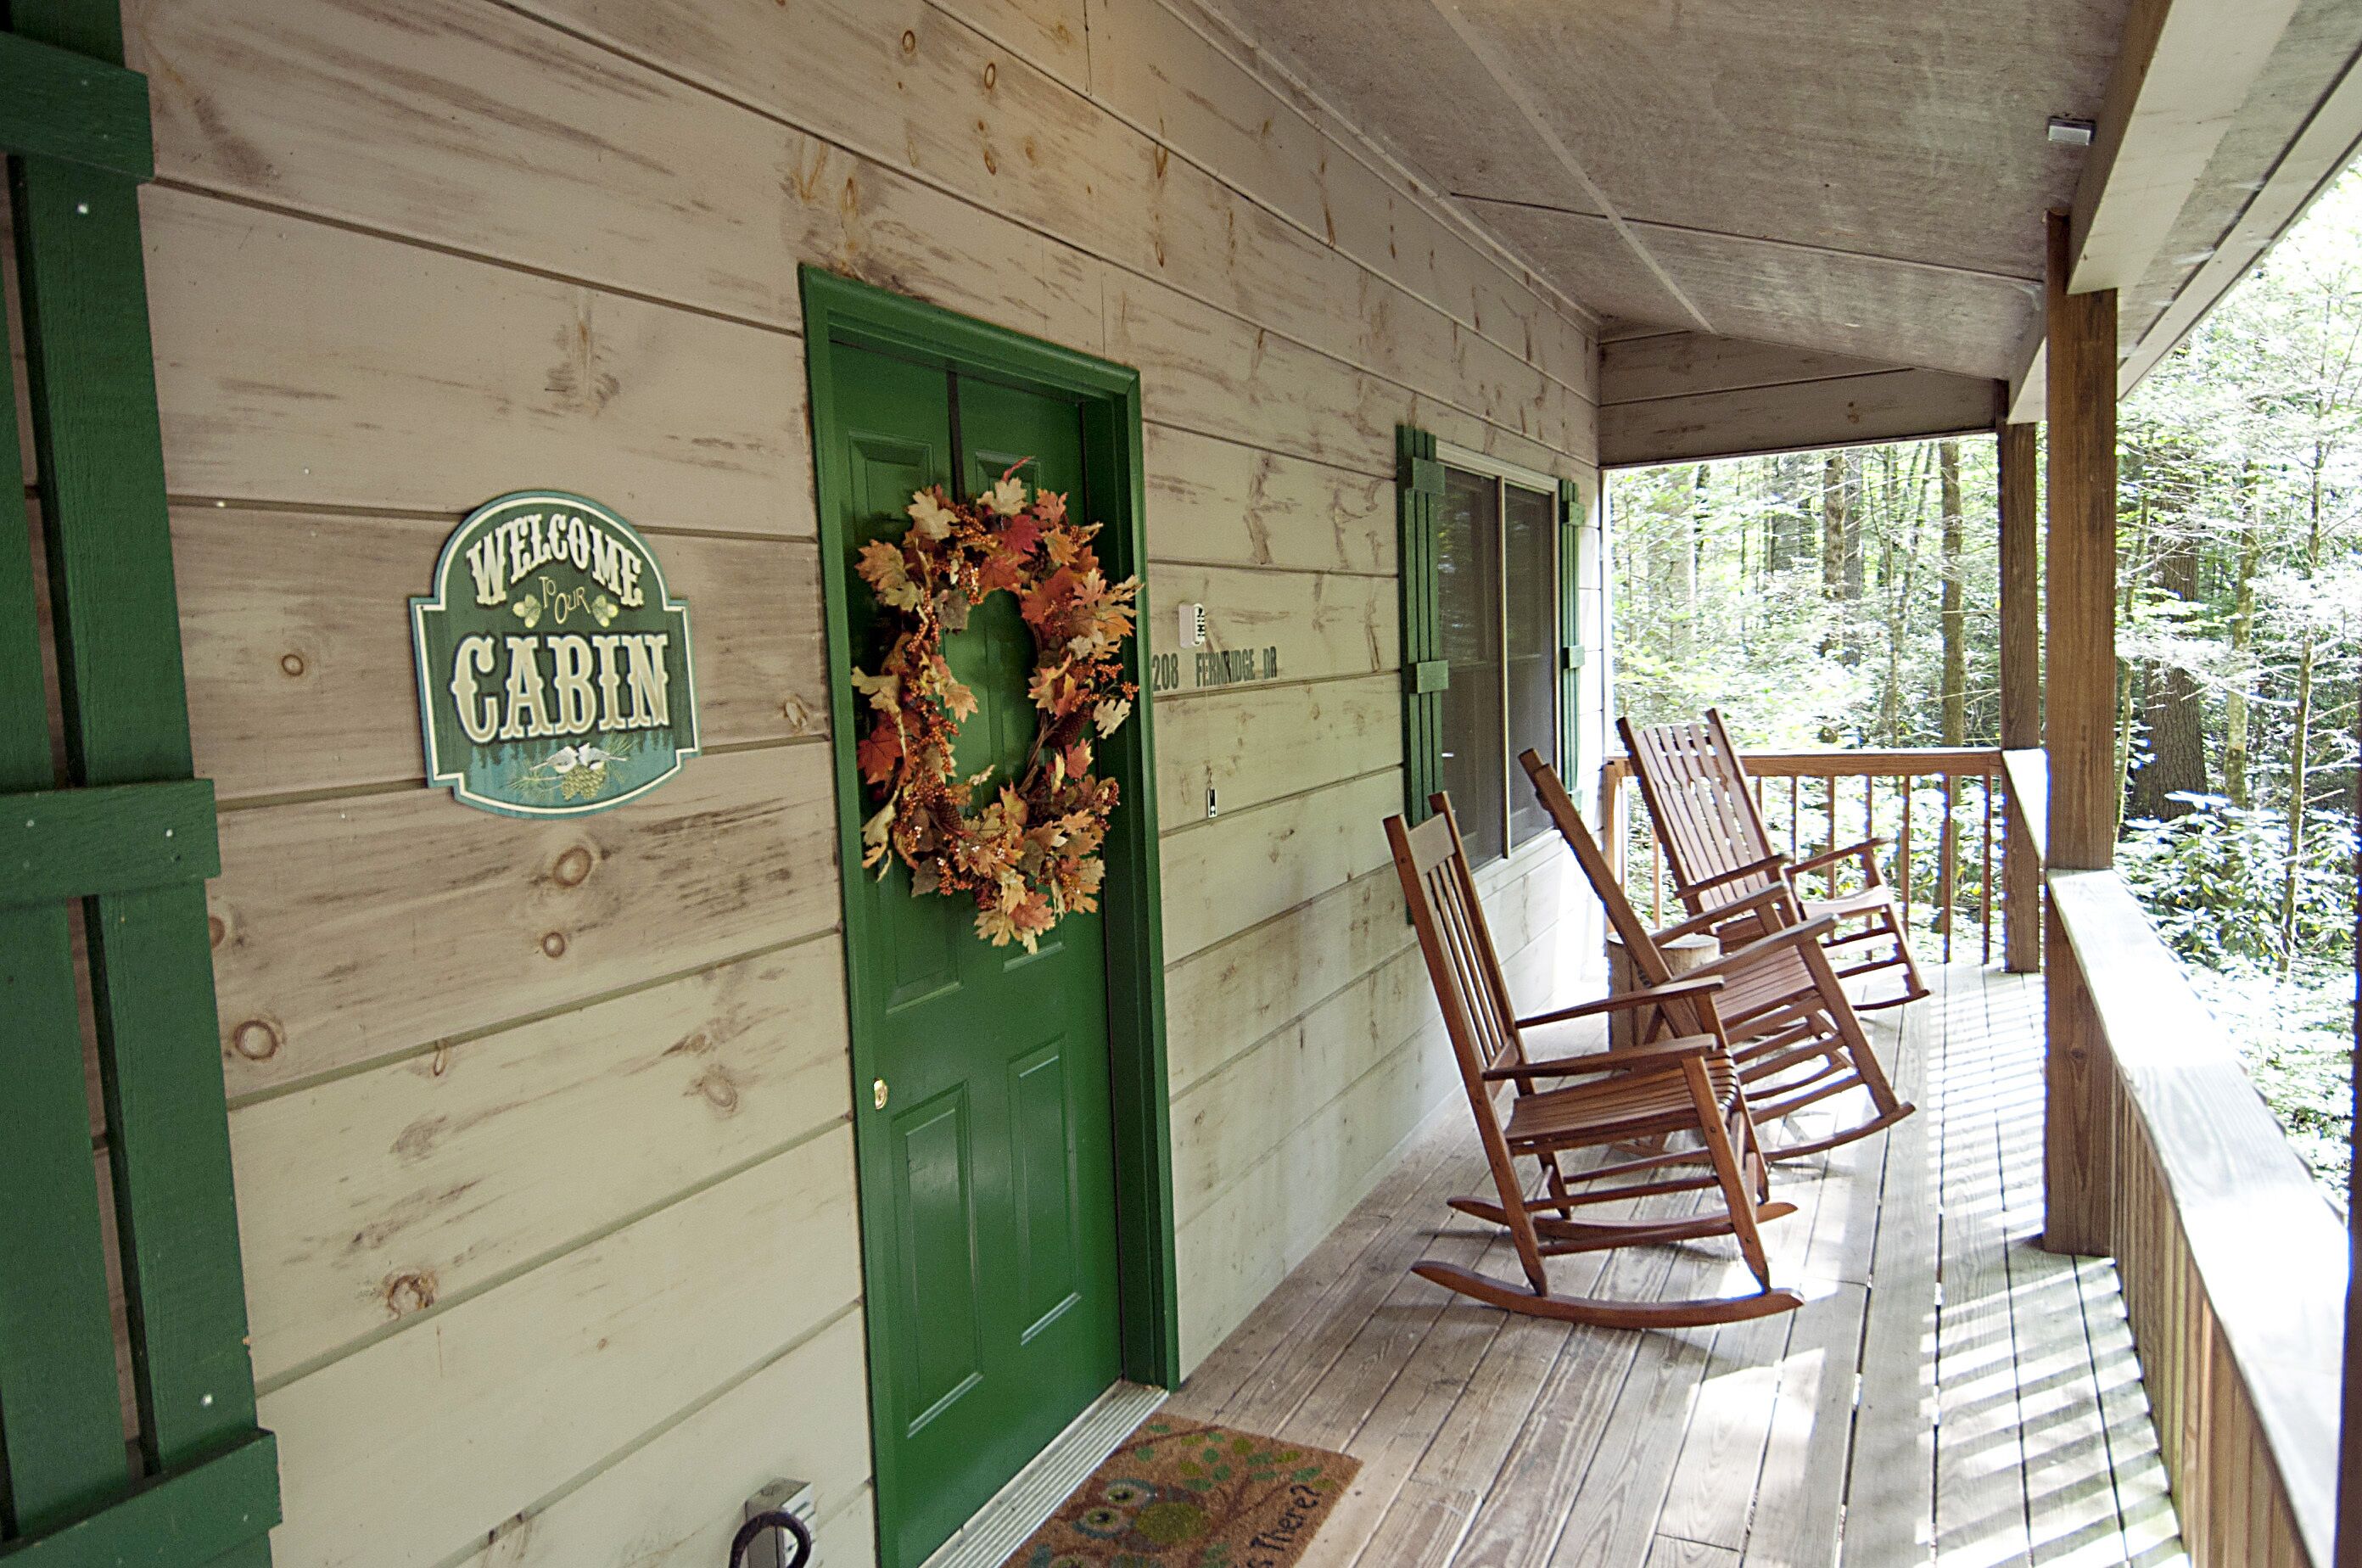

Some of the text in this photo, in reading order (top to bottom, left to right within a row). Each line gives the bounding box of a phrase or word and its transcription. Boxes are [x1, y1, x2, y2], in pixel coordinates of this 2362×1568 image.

[466, 513, 645, 607] WELCOME
[539, 576, 591, 624] TO OUR
[451, 634, 670, 743] CABIN
[1152, 652, 1179, 692] 208
[1262, 646, 1278, 679] DR
